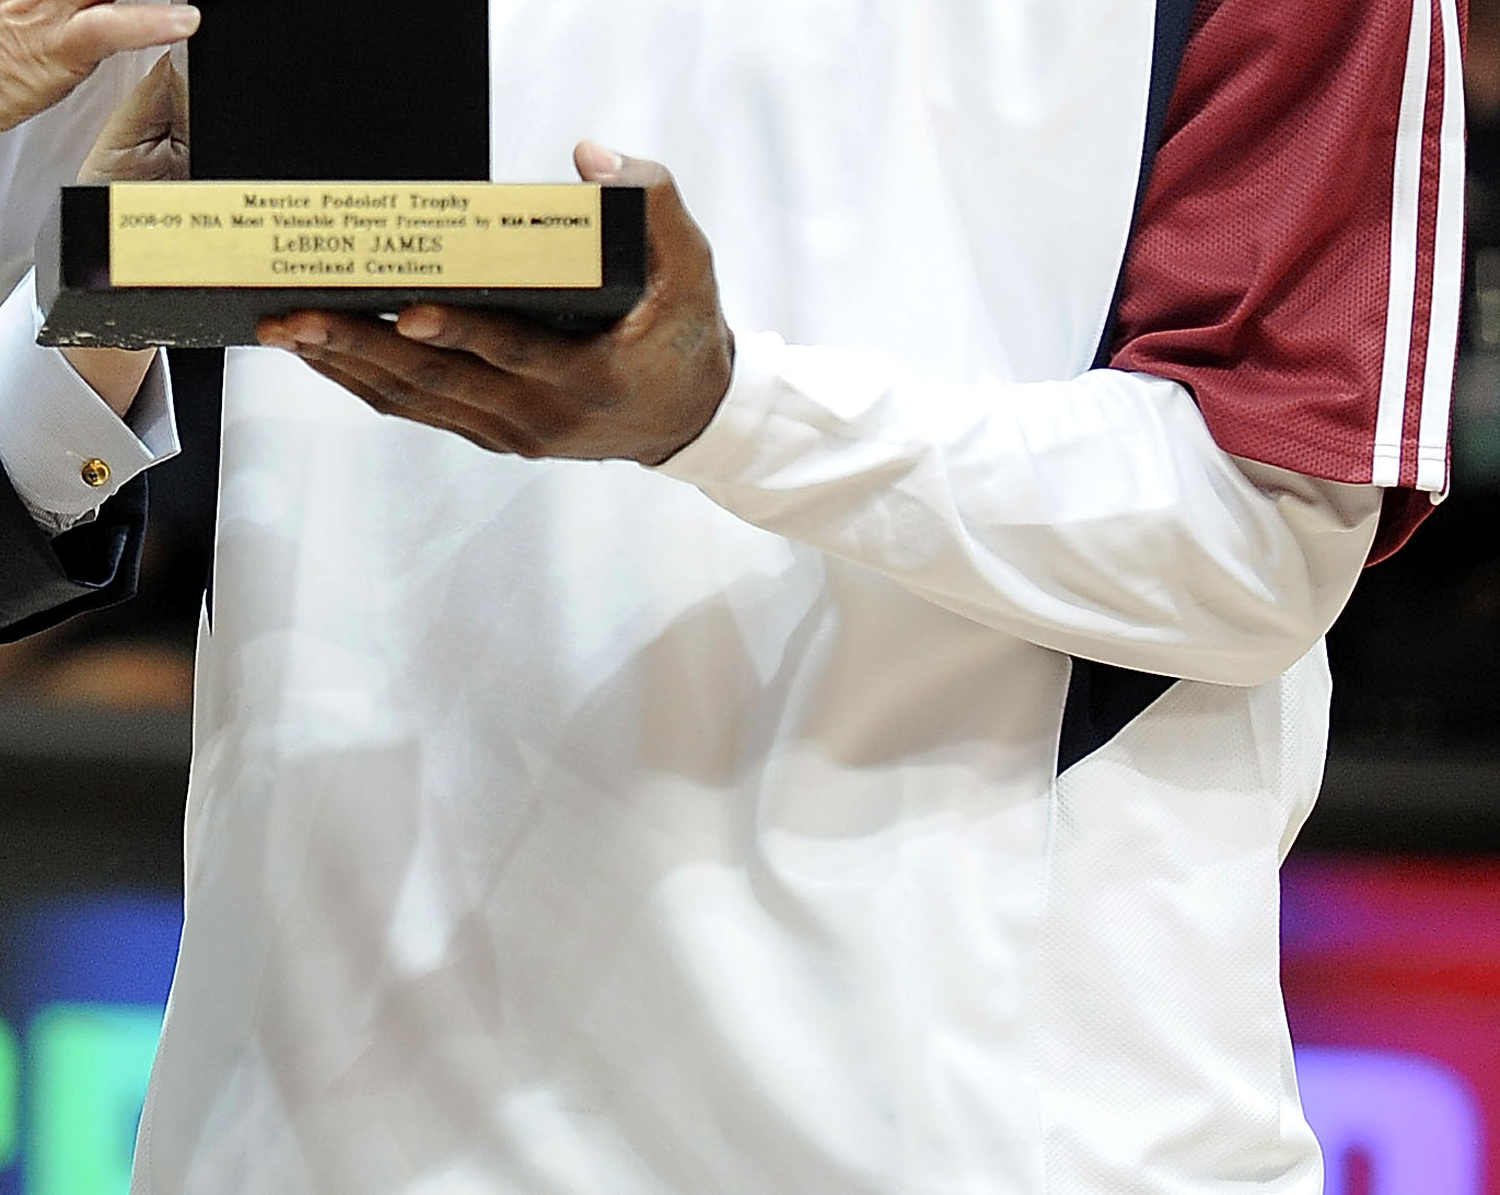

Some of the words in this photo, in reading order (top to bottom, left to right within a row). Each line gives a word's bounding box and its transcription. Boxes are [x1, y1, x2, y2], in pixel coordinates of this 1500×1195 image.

[244, 194, 311, 209] Maurice
[322, 194, 397, 209] Podoloff
[409, 194, 471, 212] Trophy
[120, 214, 183, 229] 2008-09
[190, 215, 222, 228] NBA
[231, 215, 264, 228] Most
[272, 215, 334, 228] Valuable
[344, 215, 388, 231] Player
[397, 215, 466, 229] Presented
[475, 215, 491, 230] by
[501, 216, 524, 227] KIA
[530, 216, 591, 227] MOTORS
[273, 235, 356, 254] LeBRON
[371, 235, 444, 254] JAMES
[272, 260, 355, 275] Cleveland
[366, 260, 444, 275] Cavaliers
